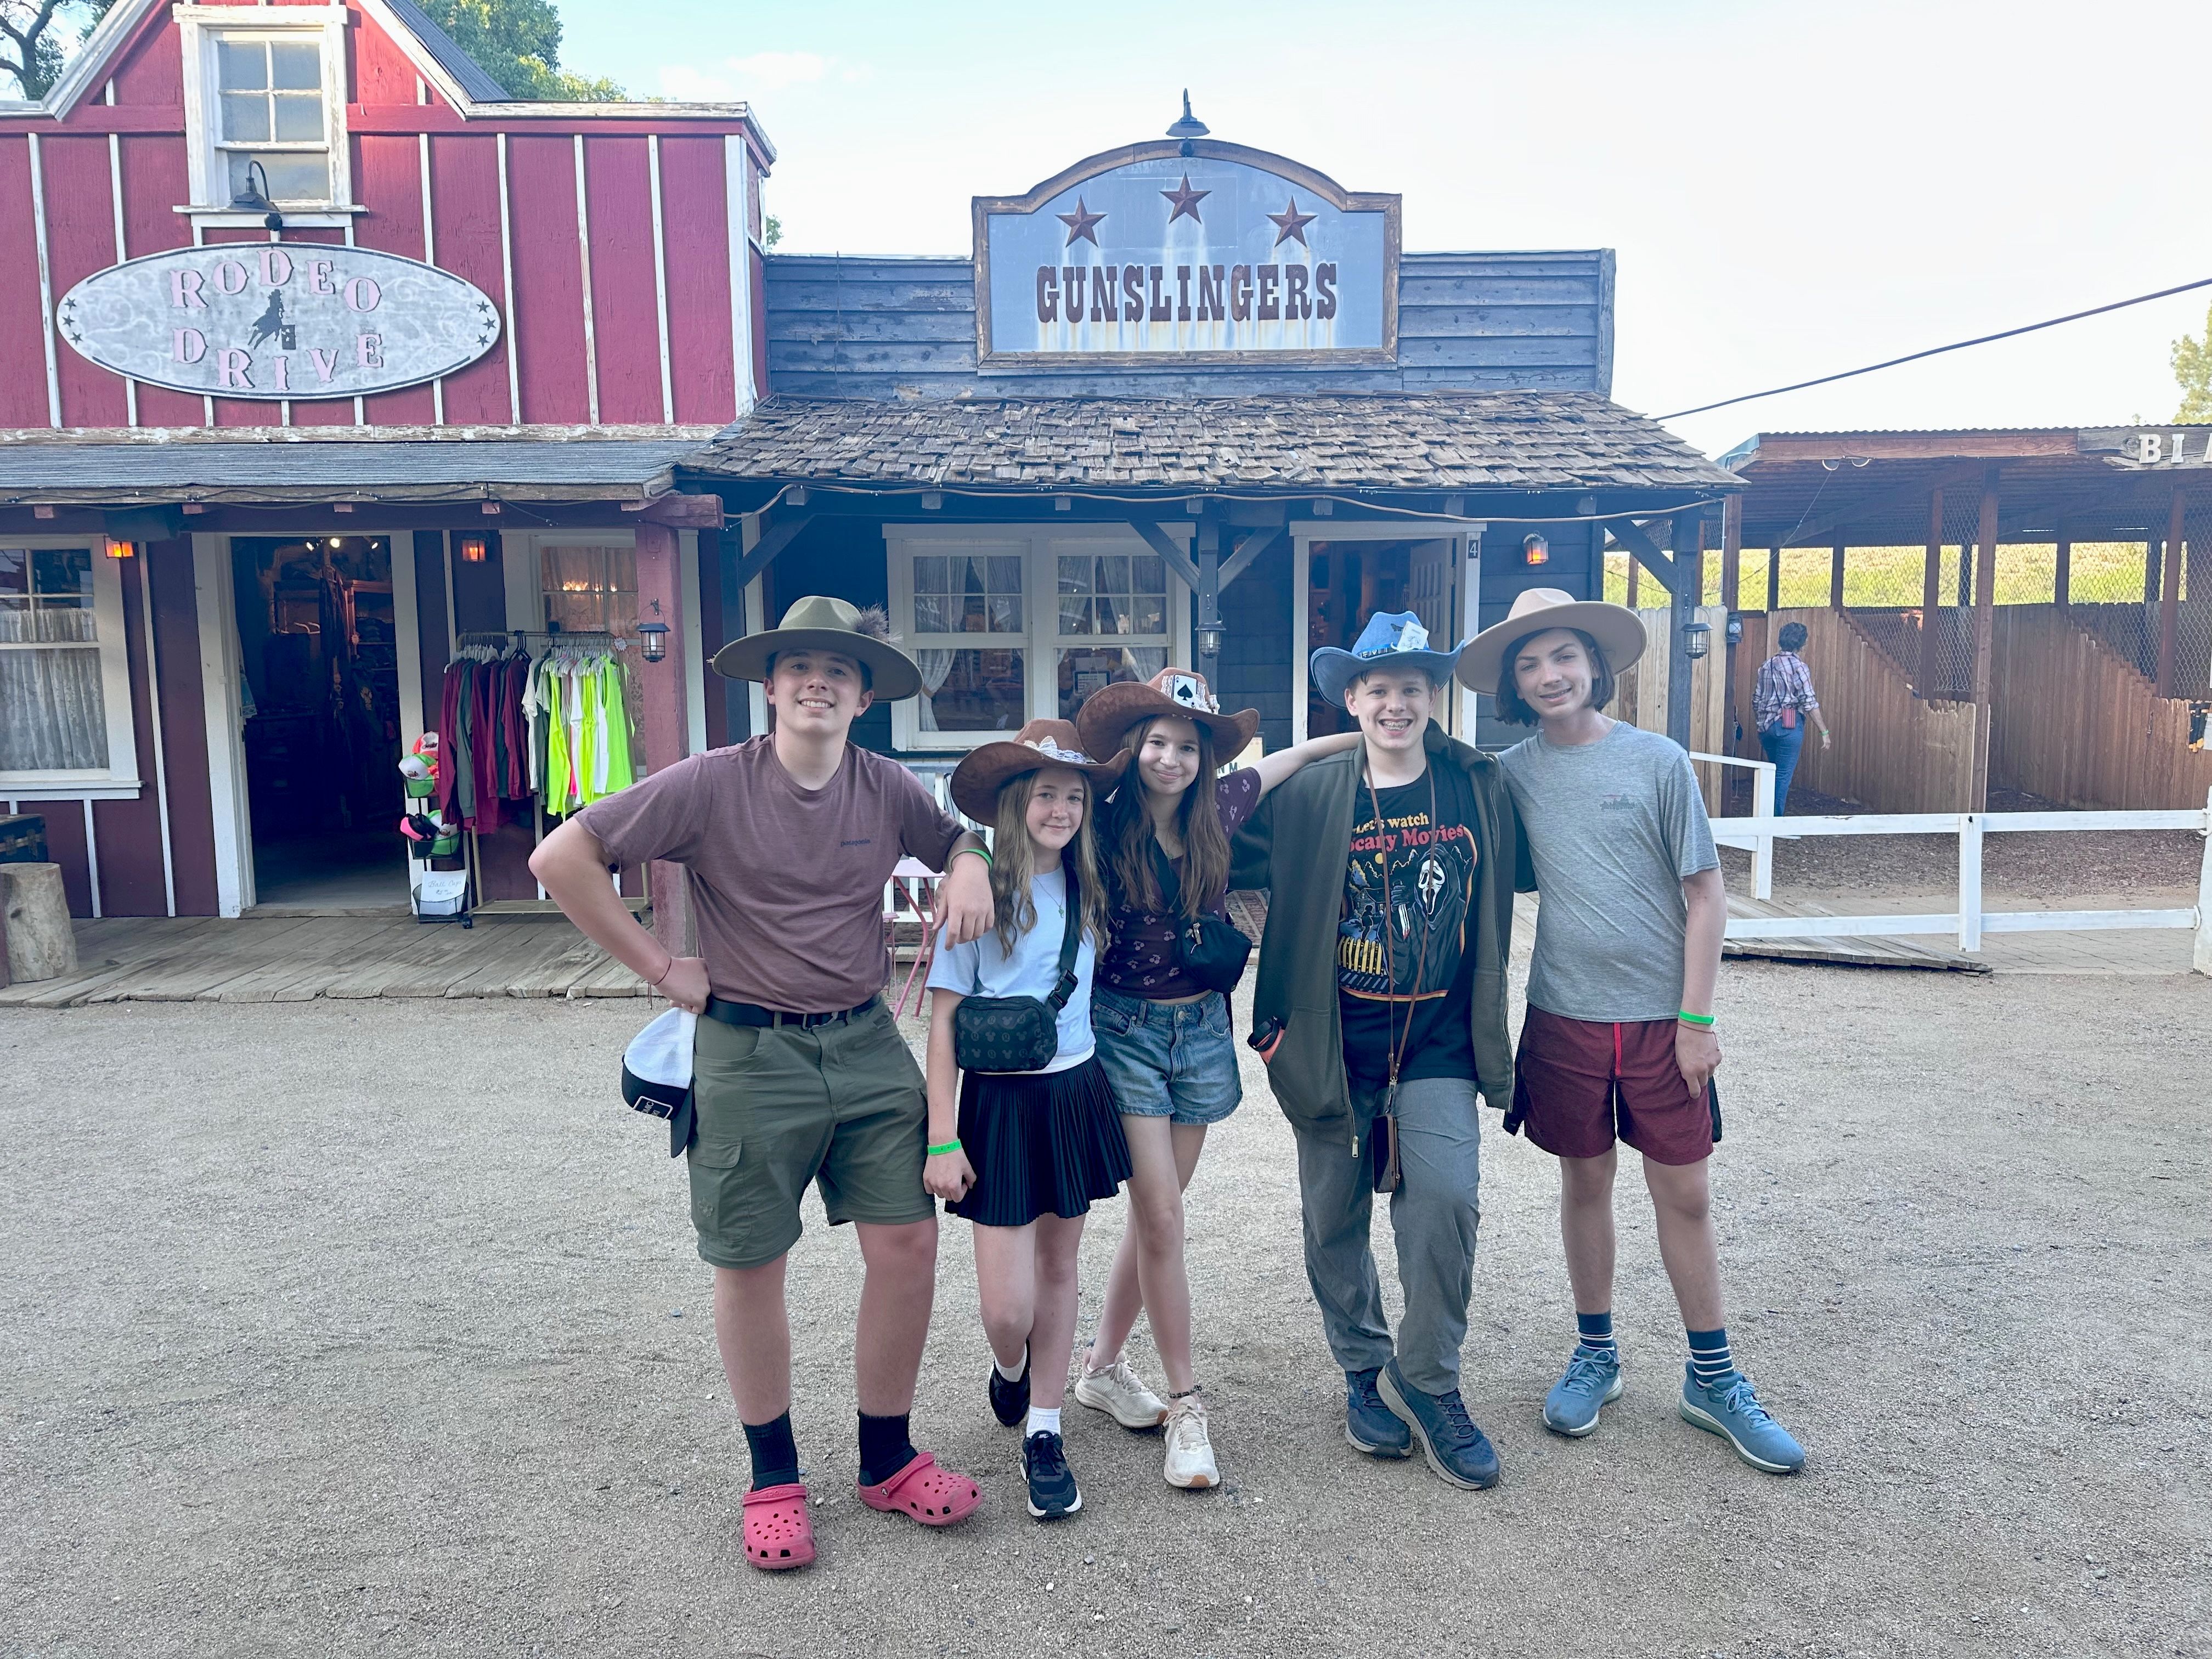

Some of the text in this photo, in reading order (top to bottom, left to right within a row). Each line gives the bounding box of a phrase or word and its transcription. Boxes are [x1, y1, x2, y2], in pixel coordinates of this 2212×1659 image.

[170, 249, 381, 313] RODEO
[1036, 263, 1337, 323] GUNSLINGERS
[172, 328, 383, 391] DRIVE
[1469, 542, 1477, 556] 4
[1387, 812, 1430, 829] watch
[1401, 823, 1464, 847] Movies
